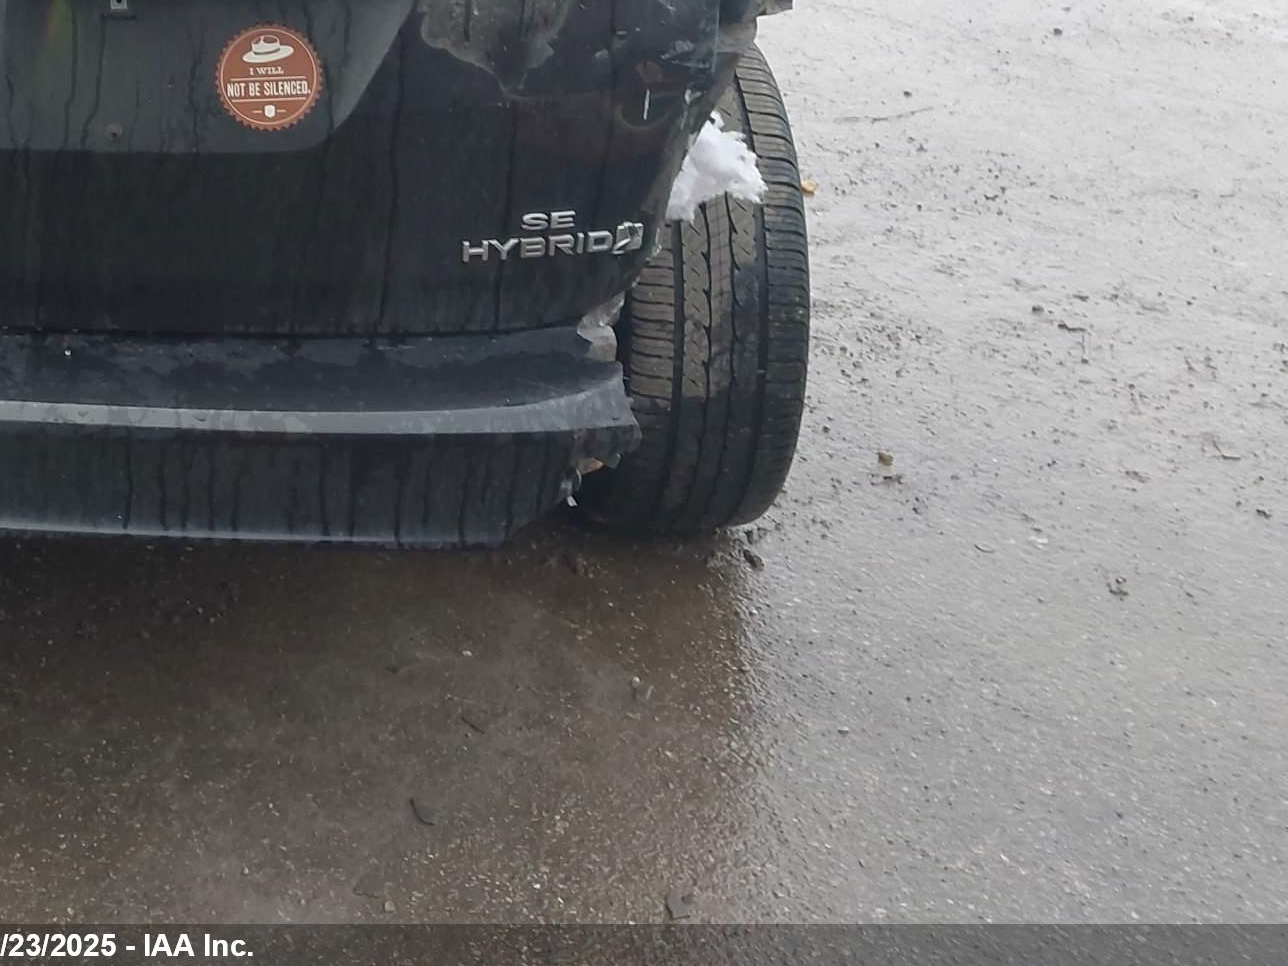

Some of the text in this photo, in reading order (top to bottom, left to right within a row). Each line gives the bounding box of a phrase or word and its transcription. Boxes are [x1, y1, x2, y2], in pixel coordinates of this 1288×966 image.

[257, 66, 284, 75] WILL
[227, 83, 246, 97] NOT
[249, 82, 260, 96] BE
[521, 210, 576, 231] SE
[462, 230, 613, 263] HYBRID
